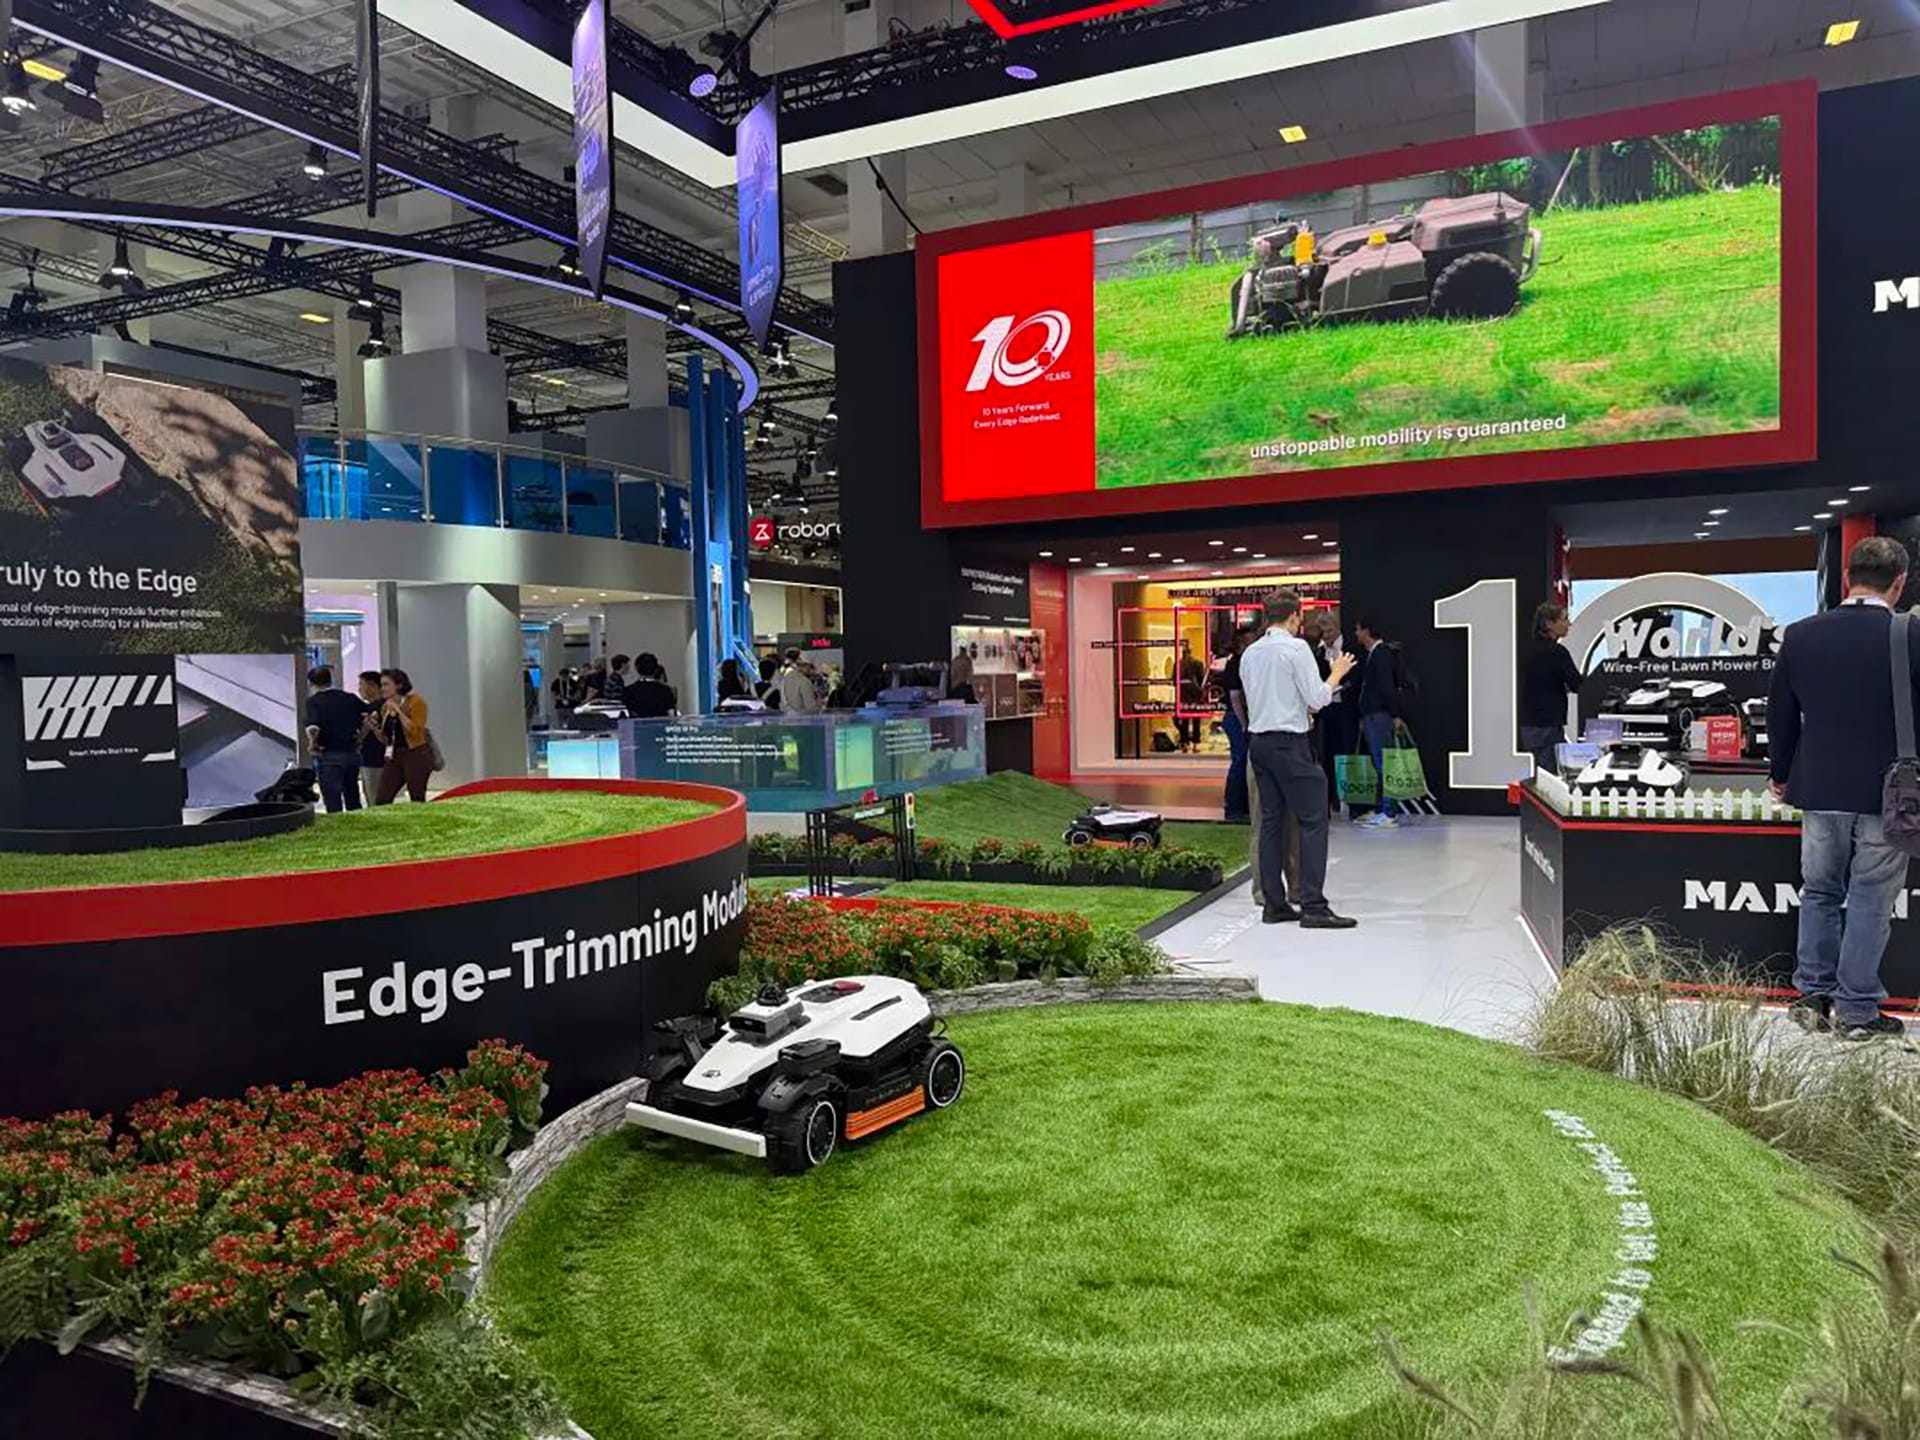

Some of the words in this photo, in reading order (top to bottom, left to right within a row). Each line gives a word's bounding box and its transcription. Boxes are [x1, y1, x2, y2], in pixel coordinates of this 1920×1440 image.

[1250, 437, 1355, 460] unstoppable
[1360, 425, 1432, 448] mobility
[1437, 422, 1453, 440] is
[1457, 413, 1566, 441] guaranteed
[54, 565, 81, 588] to
[88, 566, 130, 590] the
[137, 568, 197, 597] Edge
[20, 603, 31, 614] of
[41, 618, 52, 628] of
[54, 619, 80, 630] edge
[118, 620, 131, 630] for
[1602, 660, 1669, 673] Wire-Free
[1672, 660, 1710, 672] Lawn
[1712, 658, 1759, 671] Mower
[323, 907, 697, 1026] Edge-Trimming
